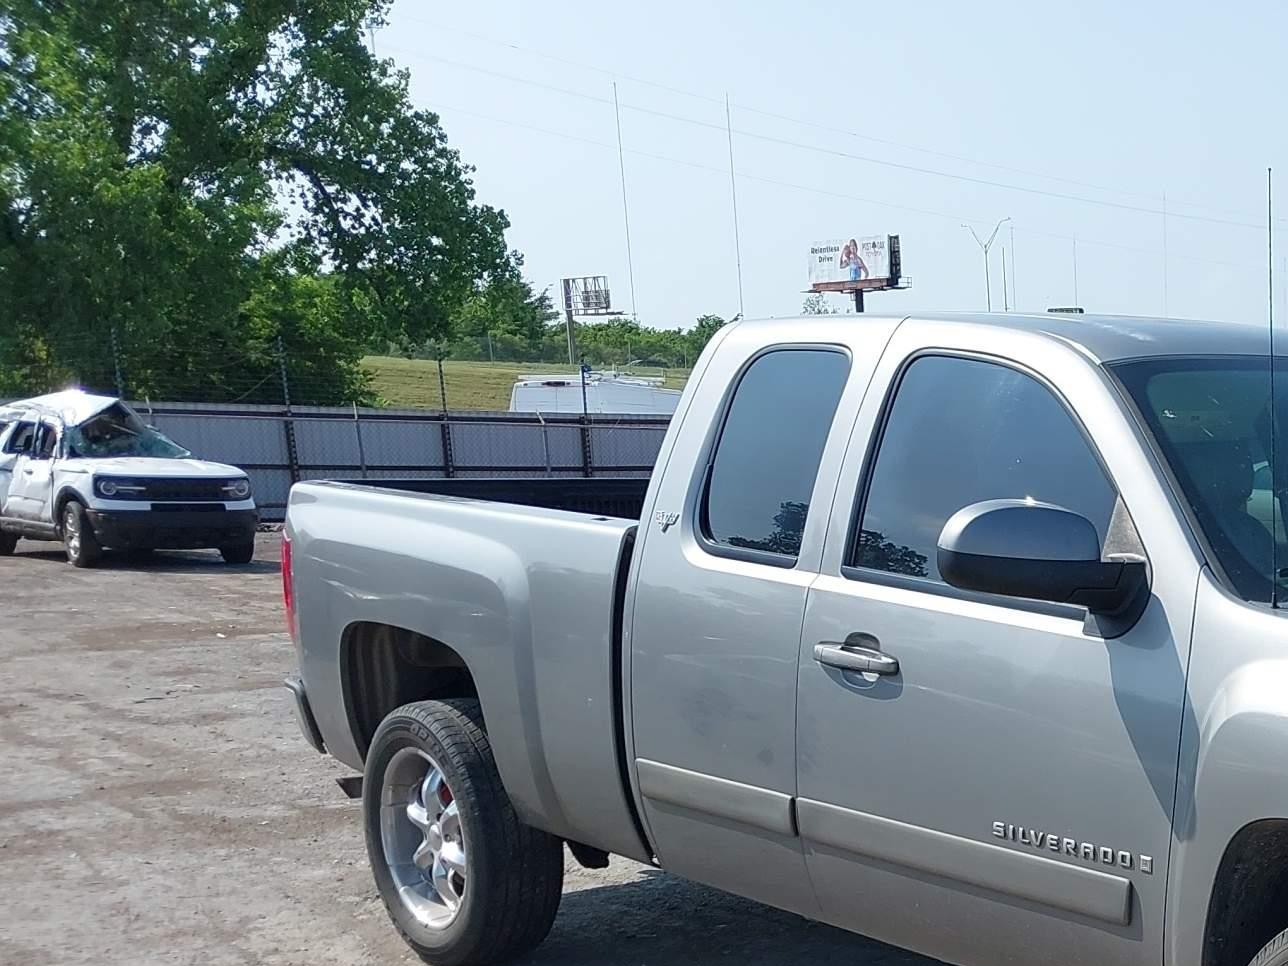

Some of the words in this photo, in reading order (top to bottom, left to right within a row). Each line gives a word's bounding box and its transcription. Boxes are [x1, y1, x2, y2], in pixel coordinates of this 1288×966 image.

[810, 245, 840, 255] Relentless
[818, 255, 833, 264] Drive
[992, 820, 1134, 869] SILVERADO
